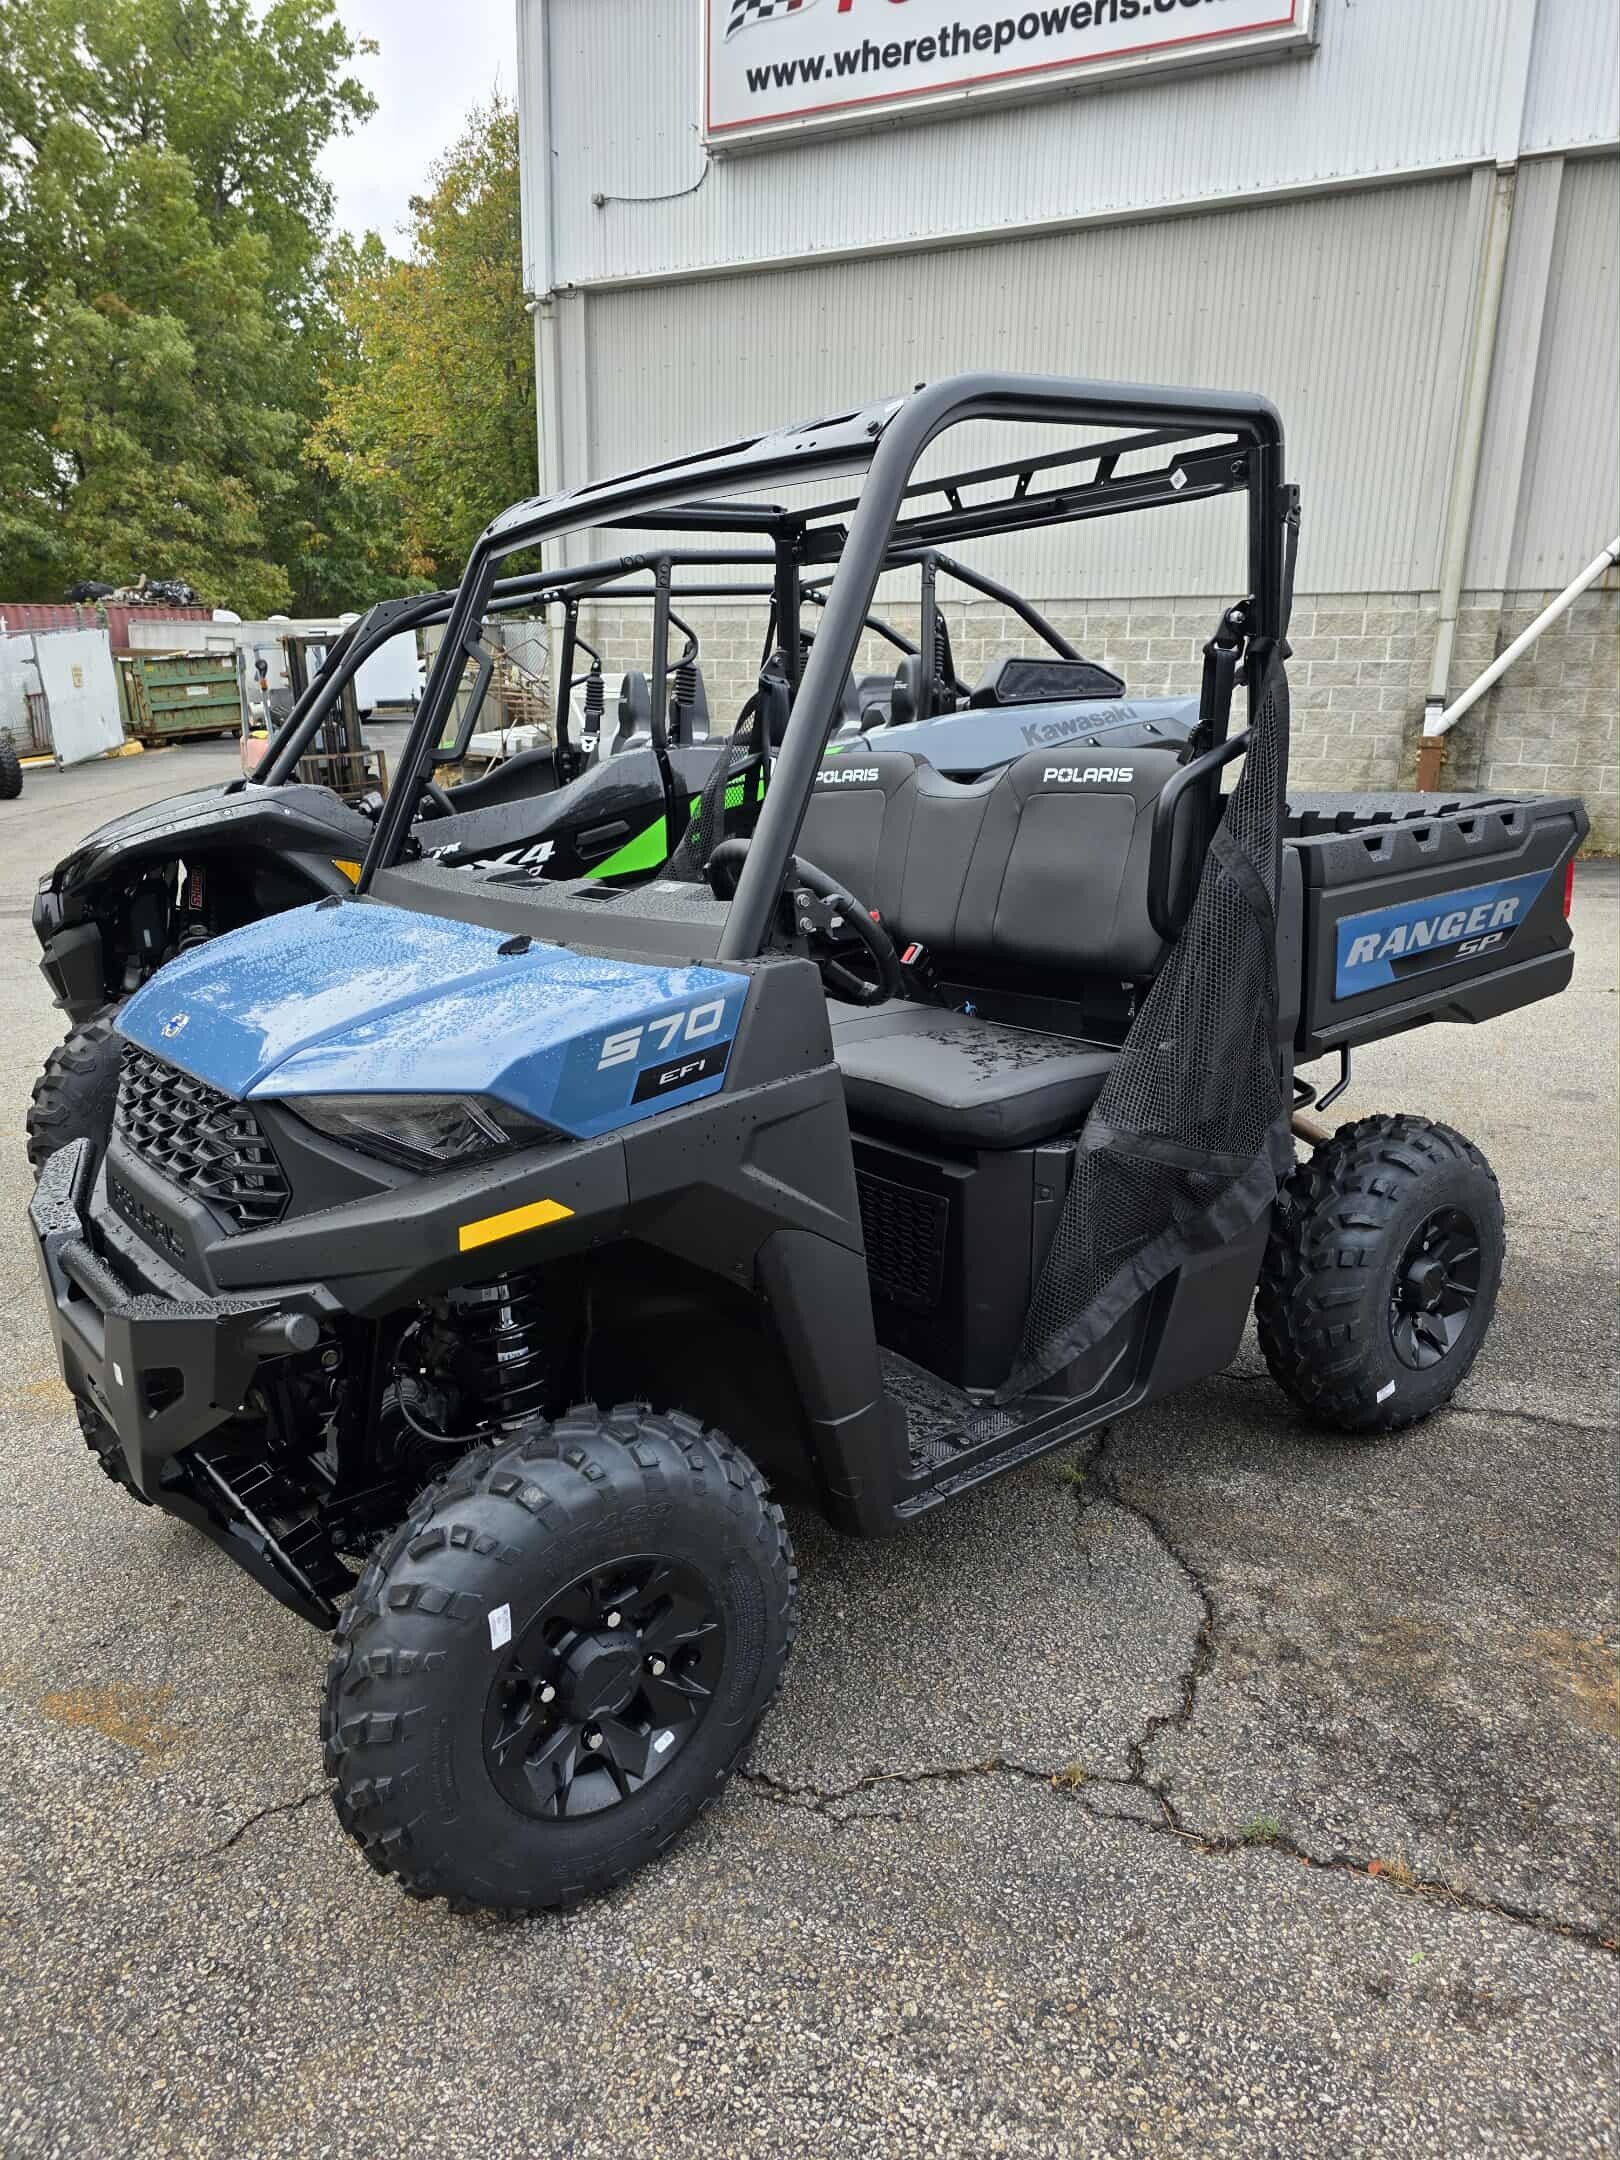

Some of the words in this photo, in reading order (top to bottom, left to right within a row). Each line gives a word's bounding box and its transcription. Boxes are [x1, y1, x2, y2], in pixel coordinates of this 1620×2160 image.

[1021, 705, 1138, 747] Kawasaki
[815, 767, 879, 784] POLARIS
[1043, 767, 1134, 783] POLARIS
[1345, 897, 1521, 968] RANGER
[1455, 931, 1504, 958] SP
[597, 999, 726, 1072] 570
[659, 1059, 706, 1085] EFI
